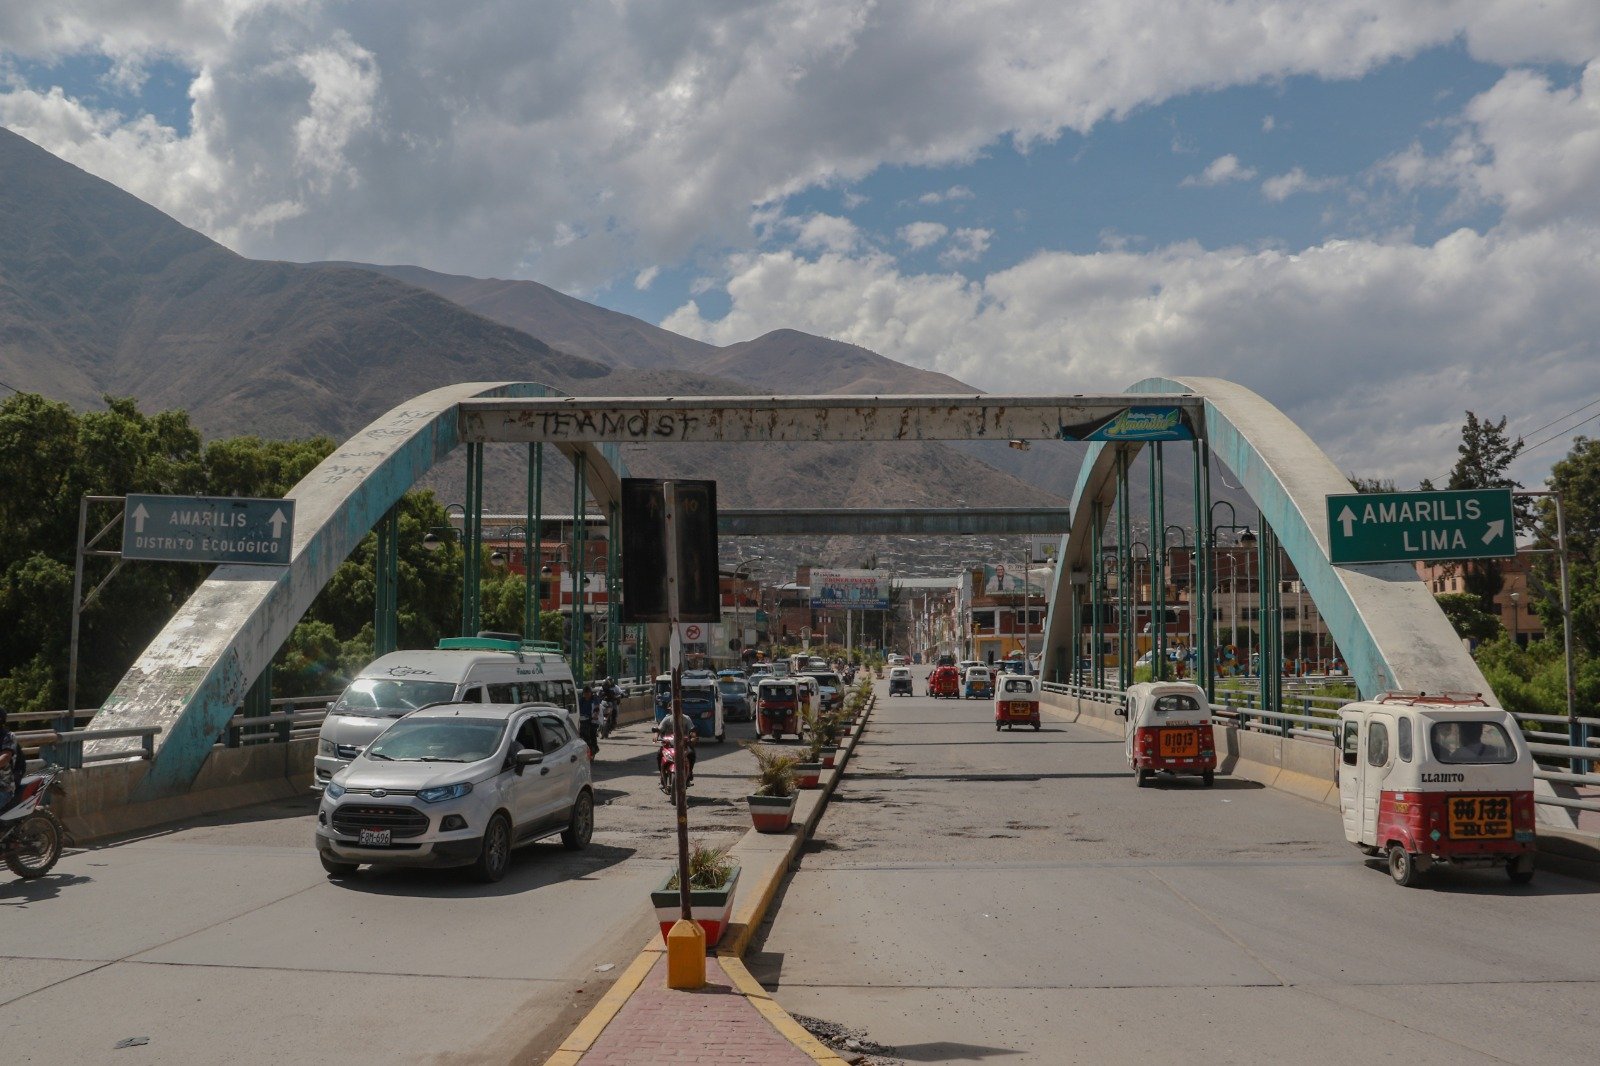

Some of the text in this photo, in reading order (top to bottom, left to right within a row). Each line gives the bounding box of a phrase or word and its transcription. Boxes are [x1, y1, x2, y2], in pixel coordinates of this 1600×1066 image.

[169, 511, 247, 527] AMARILIS
[1362, 499, 1481, 524] AMARILIS
[136, 536, 279, 554] DISTRITO ECOLÓGICO
[1403, 529, 1467, 551] LIMA
